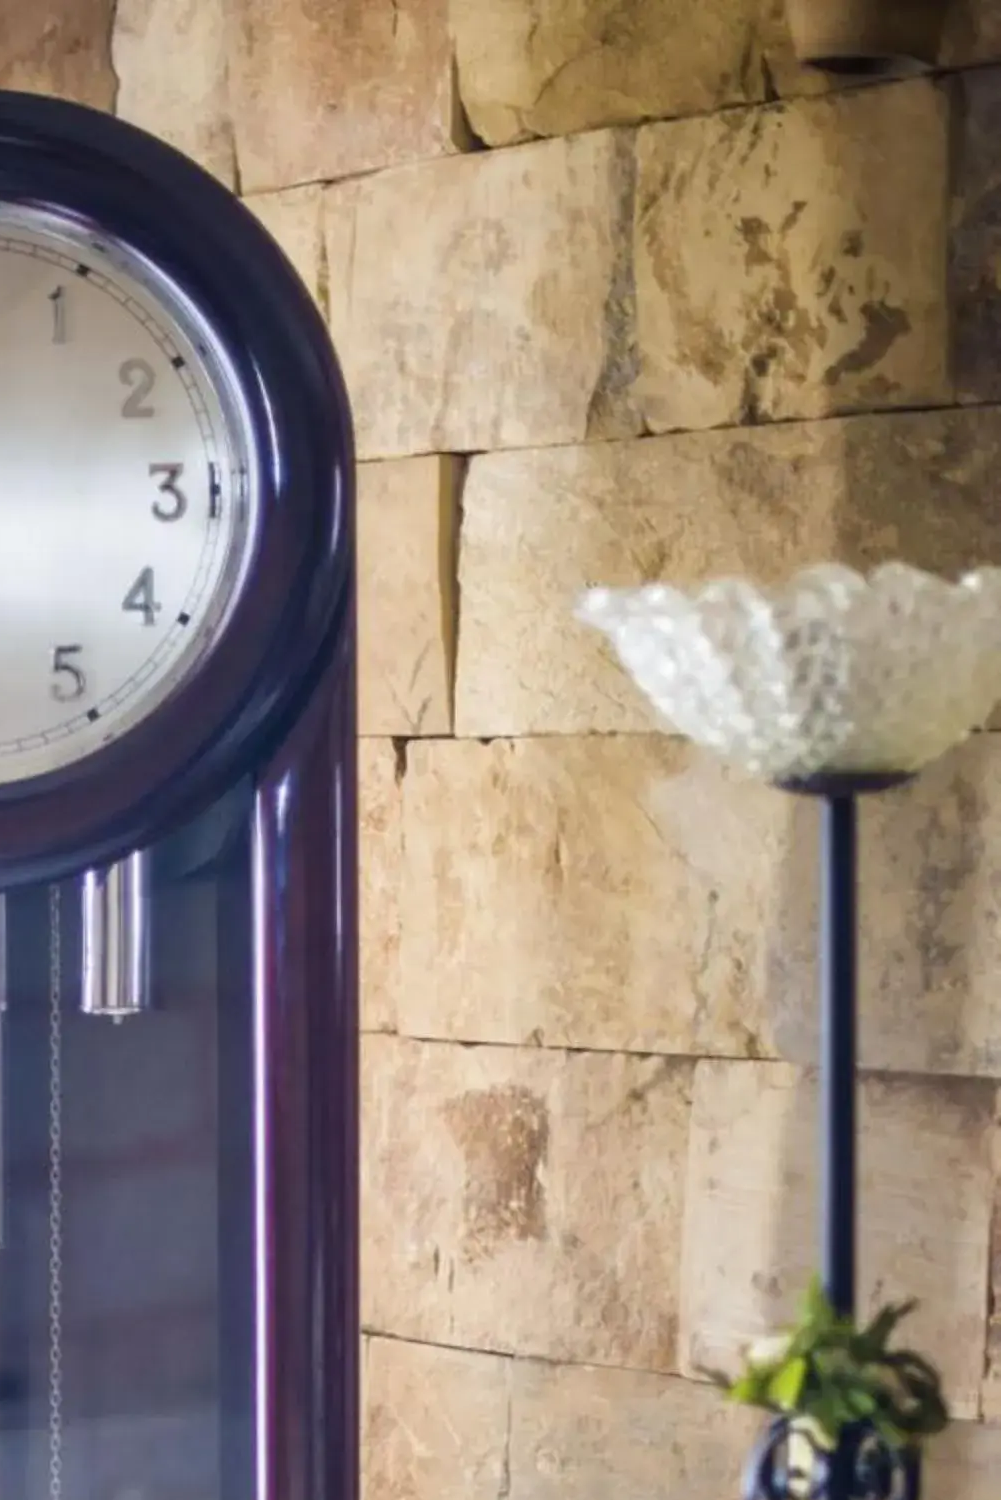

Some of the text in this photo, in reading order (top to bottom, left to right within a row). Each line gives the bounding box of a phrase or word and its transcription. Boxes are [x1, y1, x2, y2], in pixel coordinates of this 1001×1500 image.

[48, 285, 67, 344] 1
[119, 358, 156, 418] 2
[148, 462, 187, 522] 3
[121, 566, 161, 626] 4
[49, 644, 86, 702] 5
